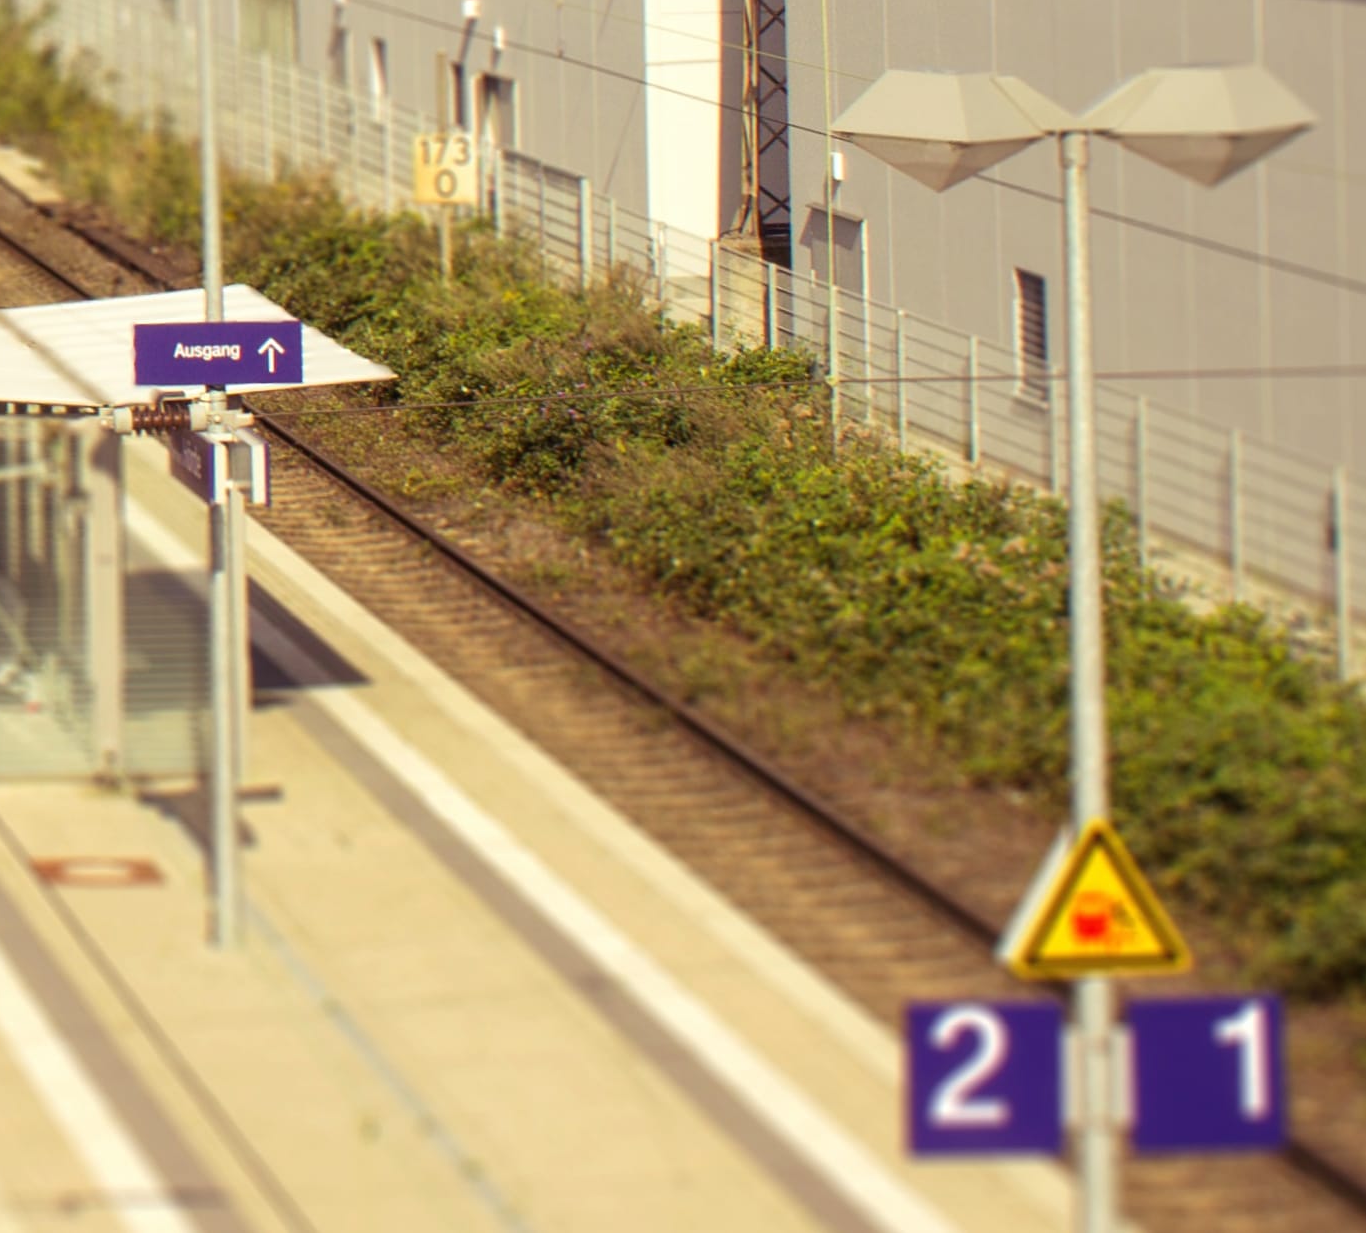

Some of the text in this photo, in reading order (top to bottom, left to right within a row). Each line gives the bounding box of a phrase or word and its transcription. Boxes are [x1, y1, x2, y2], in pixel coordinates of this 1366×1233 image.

[420, 136, 469, 165] 173
[434, 168, 457, 198] 0
[173, 342, 240, 360] Ausgang
[929, 1005, 1008, 1124] 2
[1214, 999, 1269, 1119] 1
